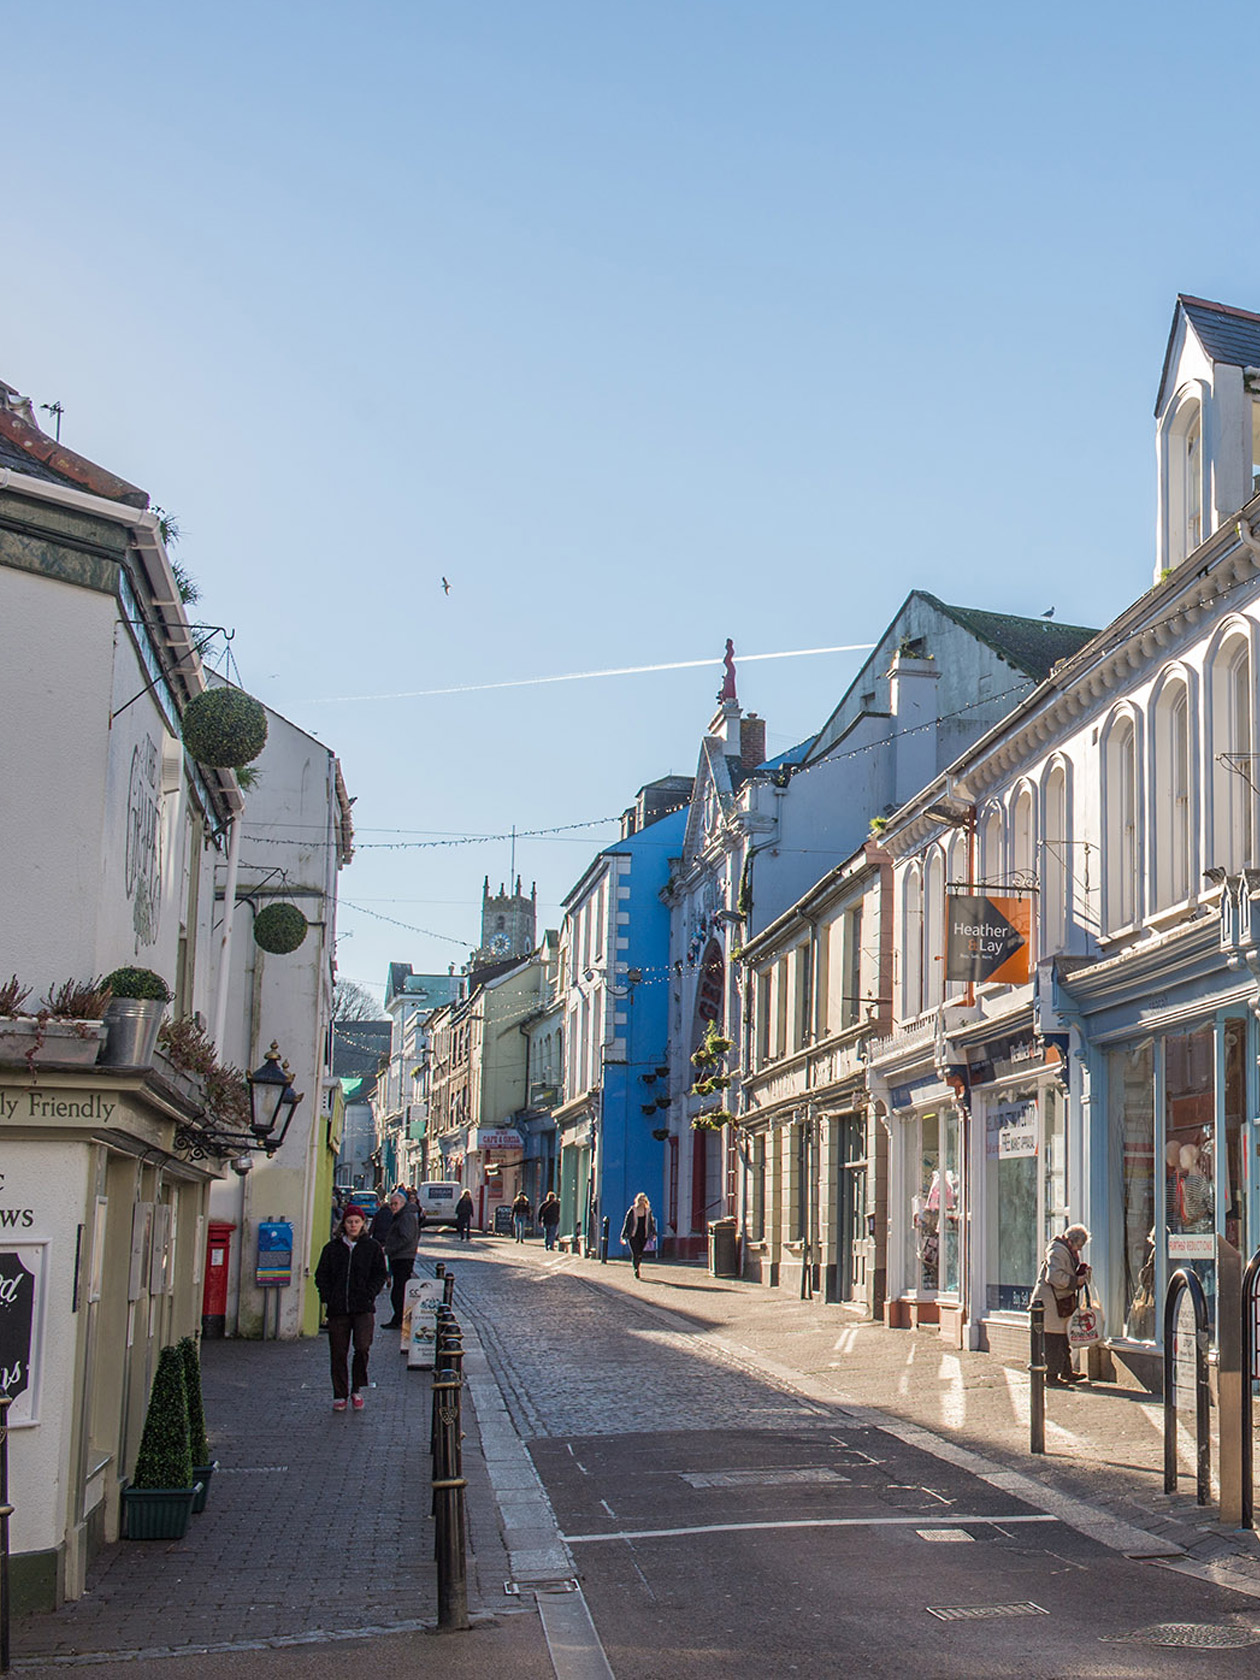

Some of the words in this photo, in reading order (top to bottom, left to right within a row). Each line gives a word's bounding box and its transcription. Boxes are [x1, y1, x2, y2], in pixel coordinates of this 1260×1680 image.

[953, 922, 1009, 938] Heather
[979, 938, 1004, 956] Lay
[28, 1092, 116, 1123] Friendly
